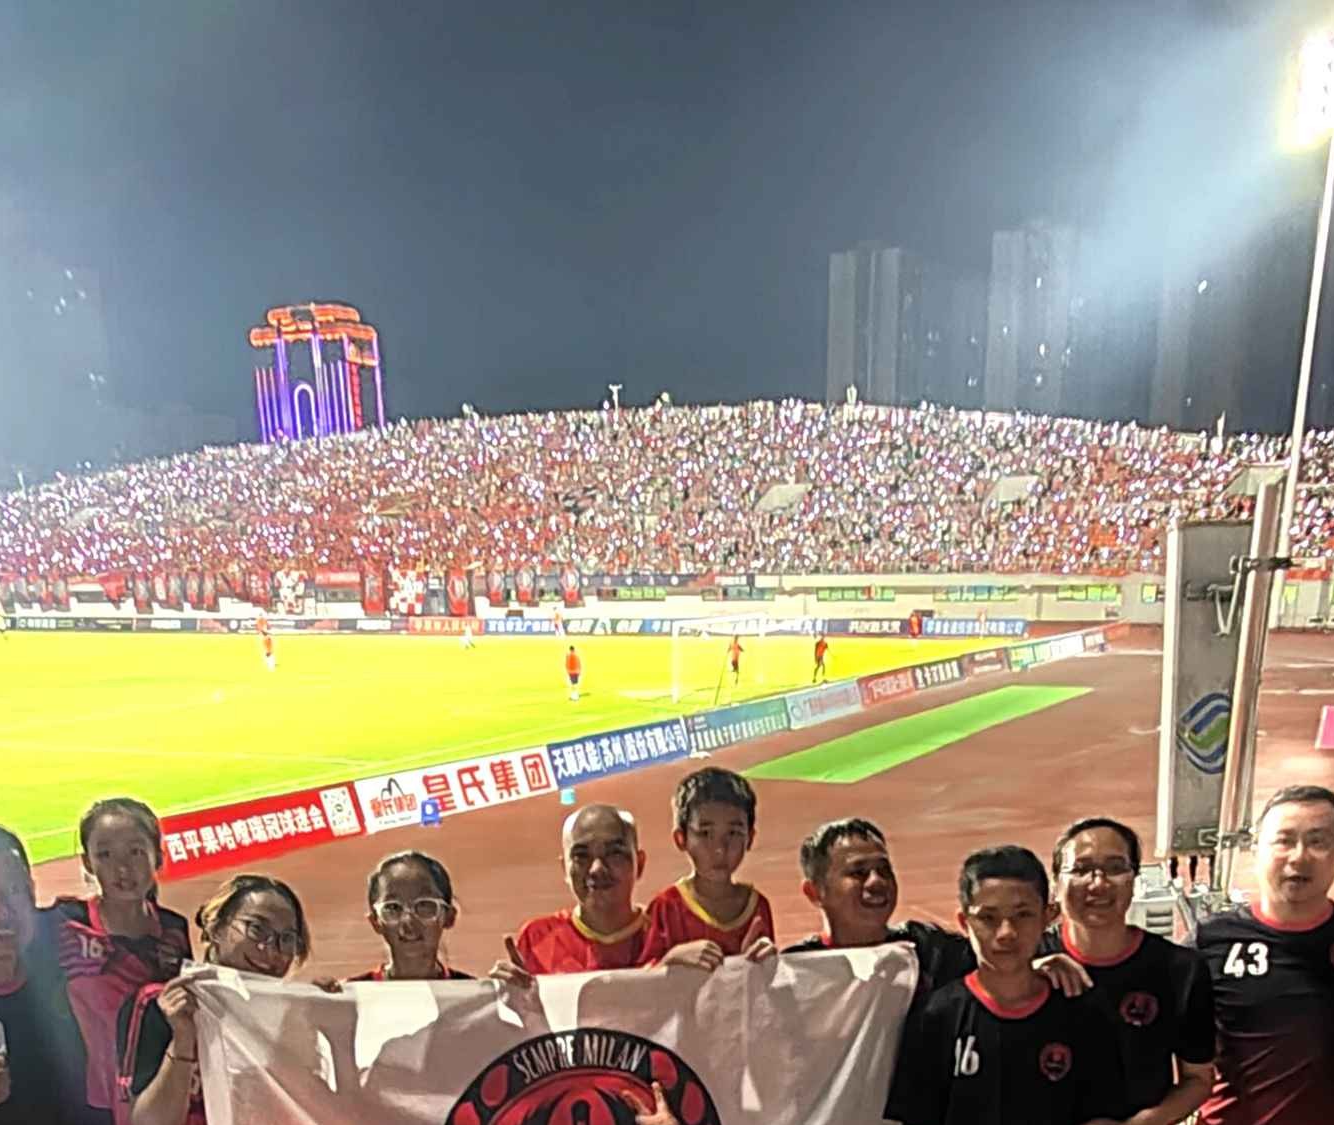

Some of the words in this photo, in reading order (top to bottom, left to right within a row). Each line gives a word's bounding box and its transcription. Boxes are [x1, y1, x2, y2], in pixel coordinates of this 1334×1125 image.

[422, 752, 552, 813] 皇氏集团
[1223, 942, 1269, 978] 43
[513, 1034, 576, 1084] SEMPRE
[582, 1033, 647, 1073] MILAN
[953, 1035, 980, 1077] 16
